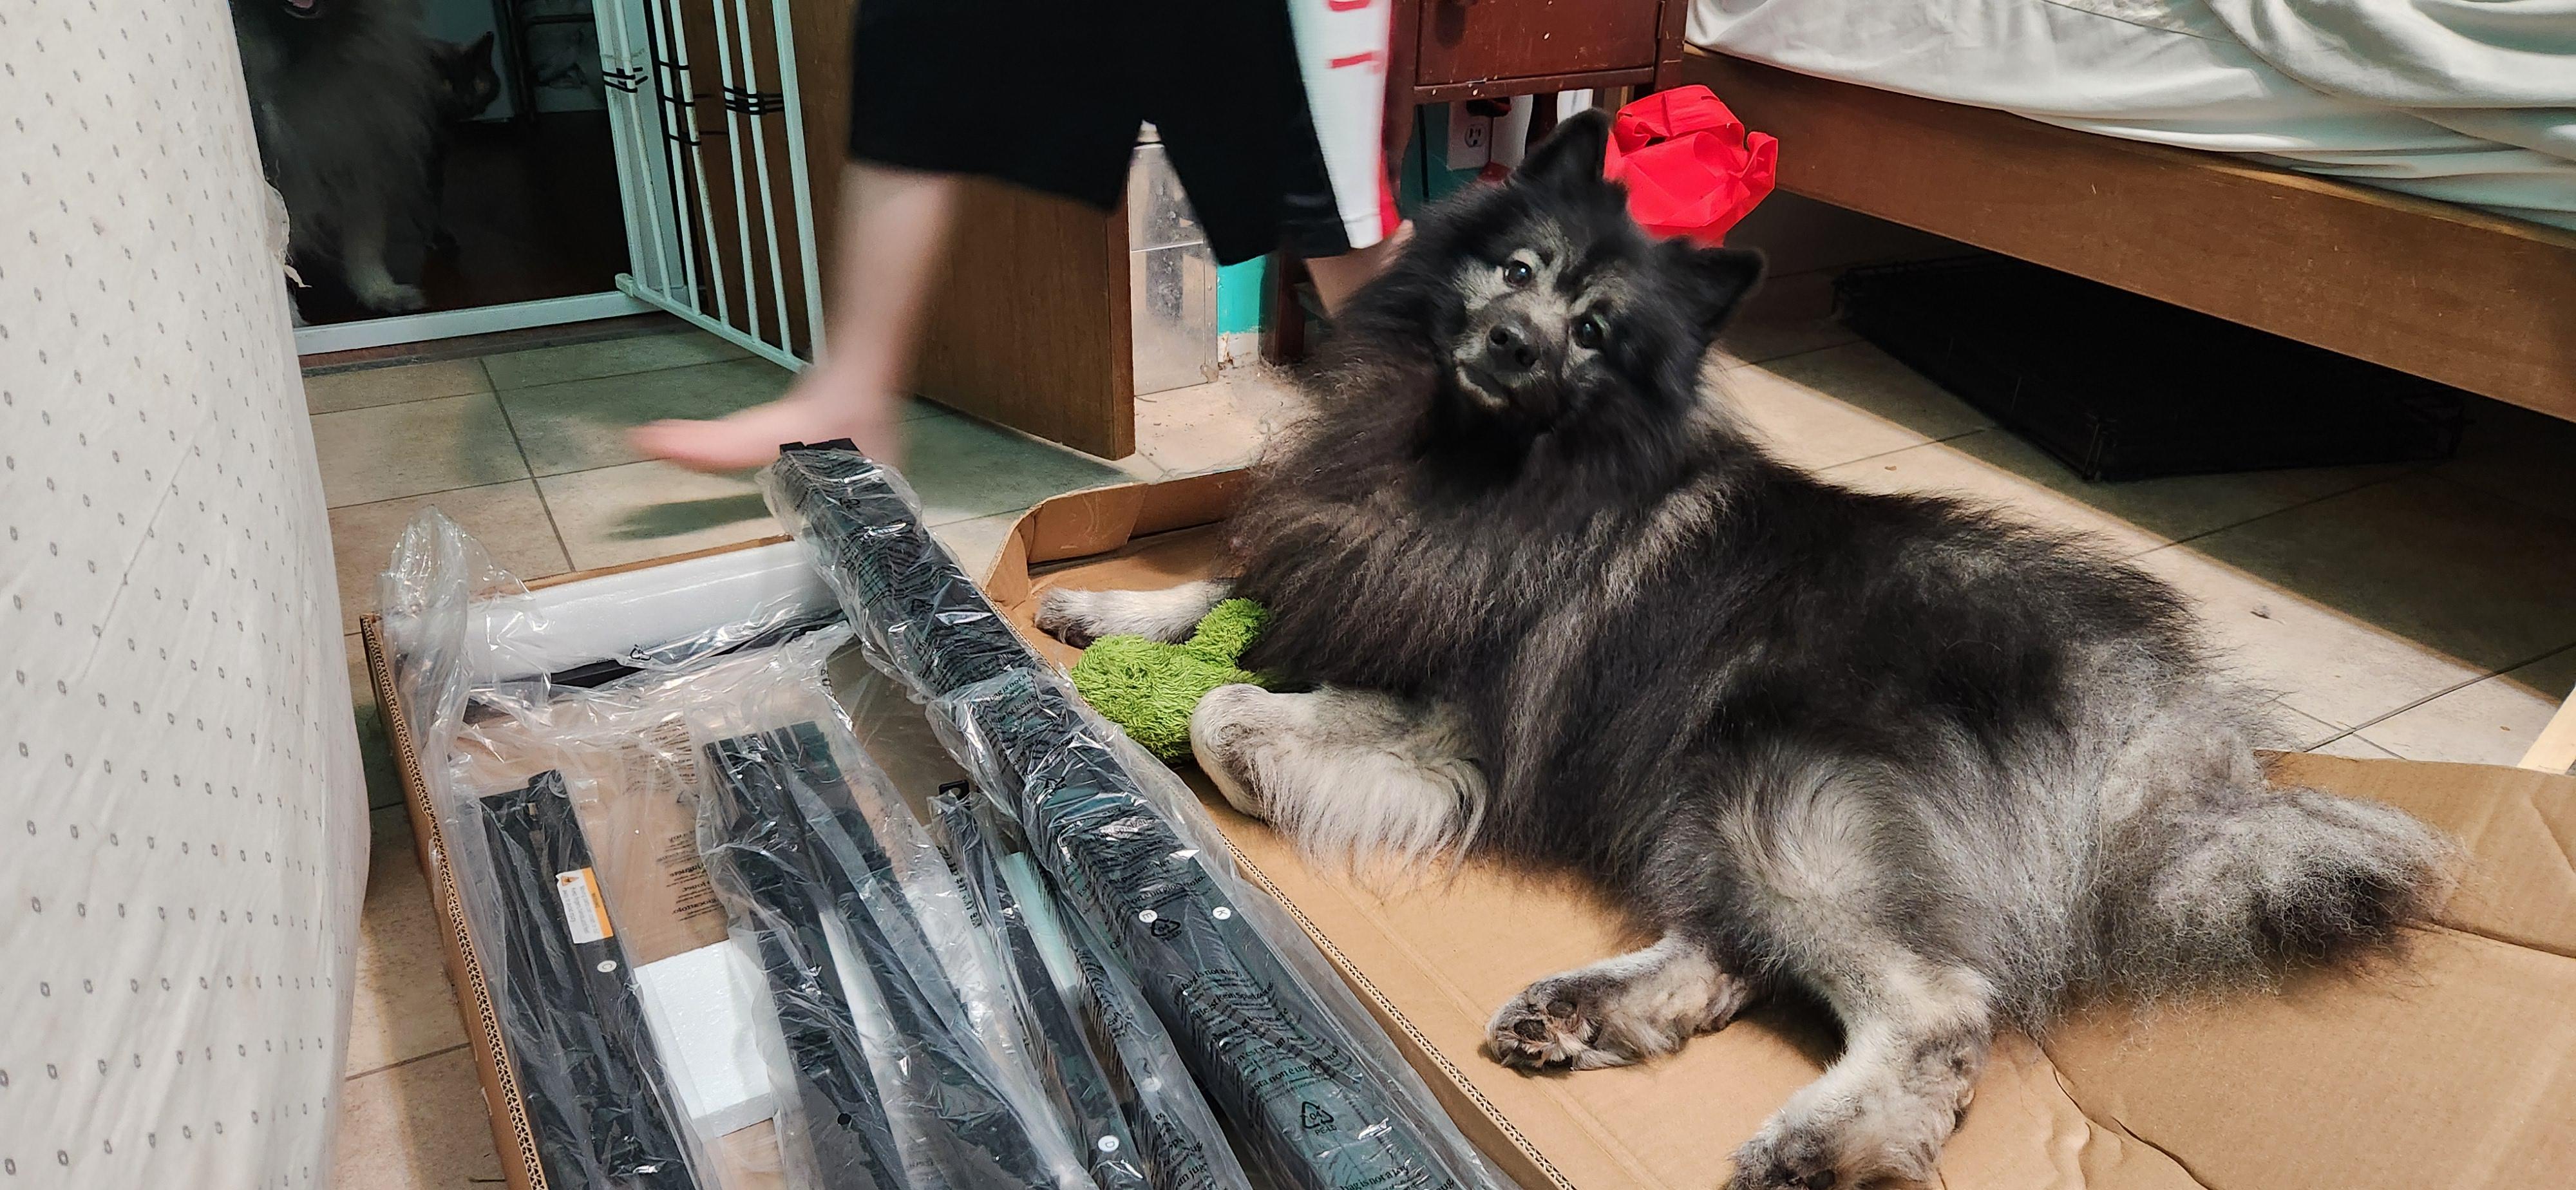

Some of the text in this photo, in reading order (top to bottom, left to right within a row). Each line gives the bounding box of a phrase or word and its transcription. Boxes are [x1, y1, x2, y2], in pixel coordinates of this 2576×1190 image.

[1009, 677, 1022, 688] not
[1014, 698, 1032, 712] kein
[1269, 1070, 1288, 1083] non
[1295, 1064, 1309, 1073] un
[1309, 1111, 1323, 1120] 04
[1369, 1173, 1386, 1186] not
[1385, 1170, 1394, 1179] a
